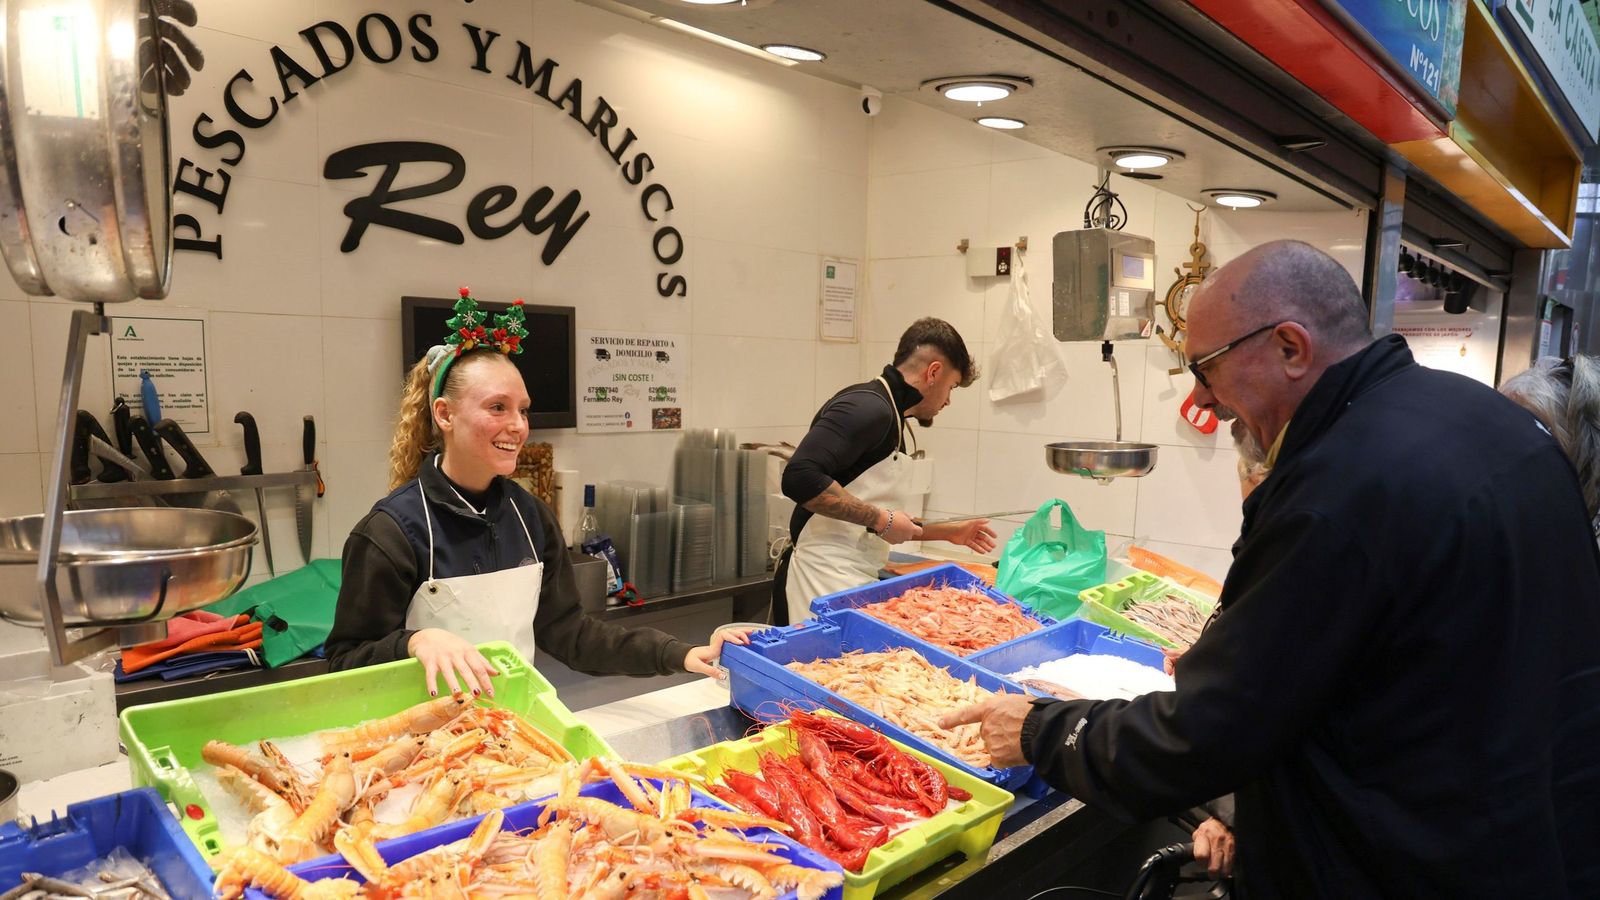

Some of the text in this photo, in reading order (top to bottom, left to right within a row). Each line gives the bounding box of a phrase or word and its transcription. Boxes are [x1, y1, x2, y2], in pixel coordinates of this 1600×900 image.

[1565, 4, 1596, 96] CASITA
[172, 12, 687, 298] PESCADOS Y MARISCOS
[323, 140, 590, 266] Rey
[590, 336, 675, 348] SERVICIO DE REPARTO A
[615, 349, 653, 358] DOMICILIO
[628, 373, 650, 382] COSTE
[611, 396, 623, 404] Rey
